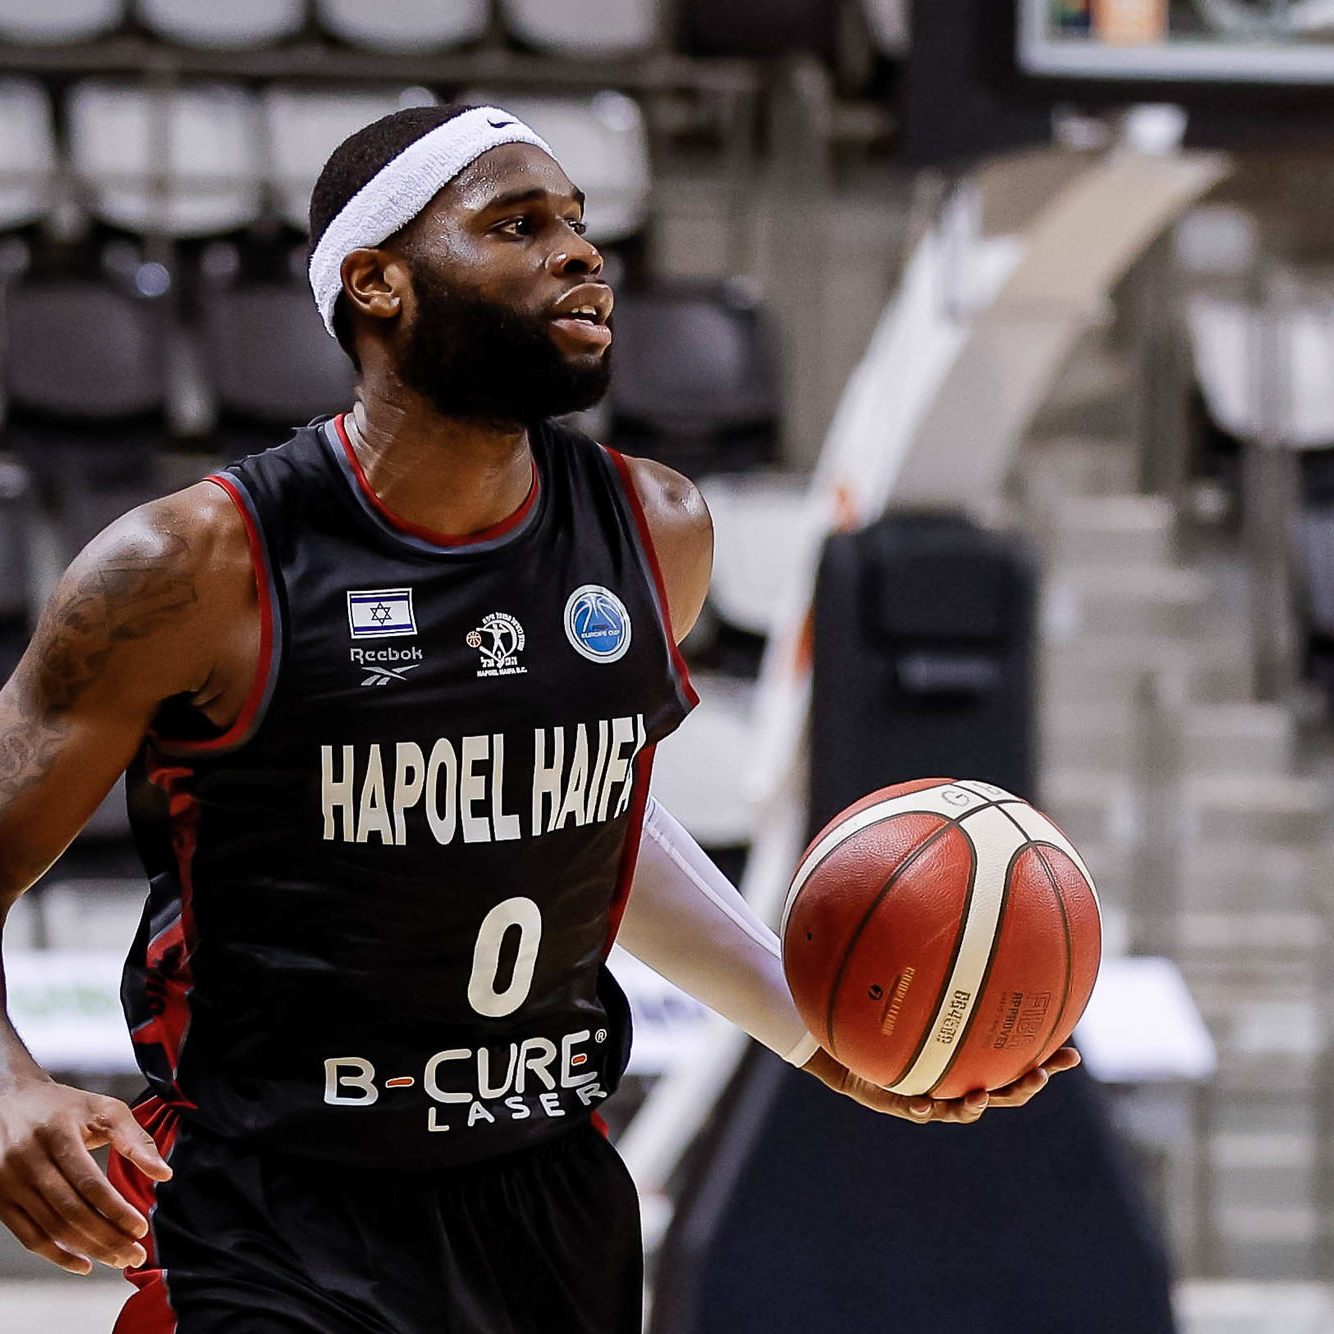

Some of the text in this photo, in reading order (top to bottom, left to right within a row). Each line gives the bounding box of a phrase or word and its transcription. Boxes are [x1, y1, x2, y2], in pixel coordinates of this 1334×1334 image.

[349, 646, 424, 665] Reebok
[320, 732, 522, 847] HAPOEL
[467, 896, 543, 1019] 0
[427, 1081, 608, 1132] LASER
